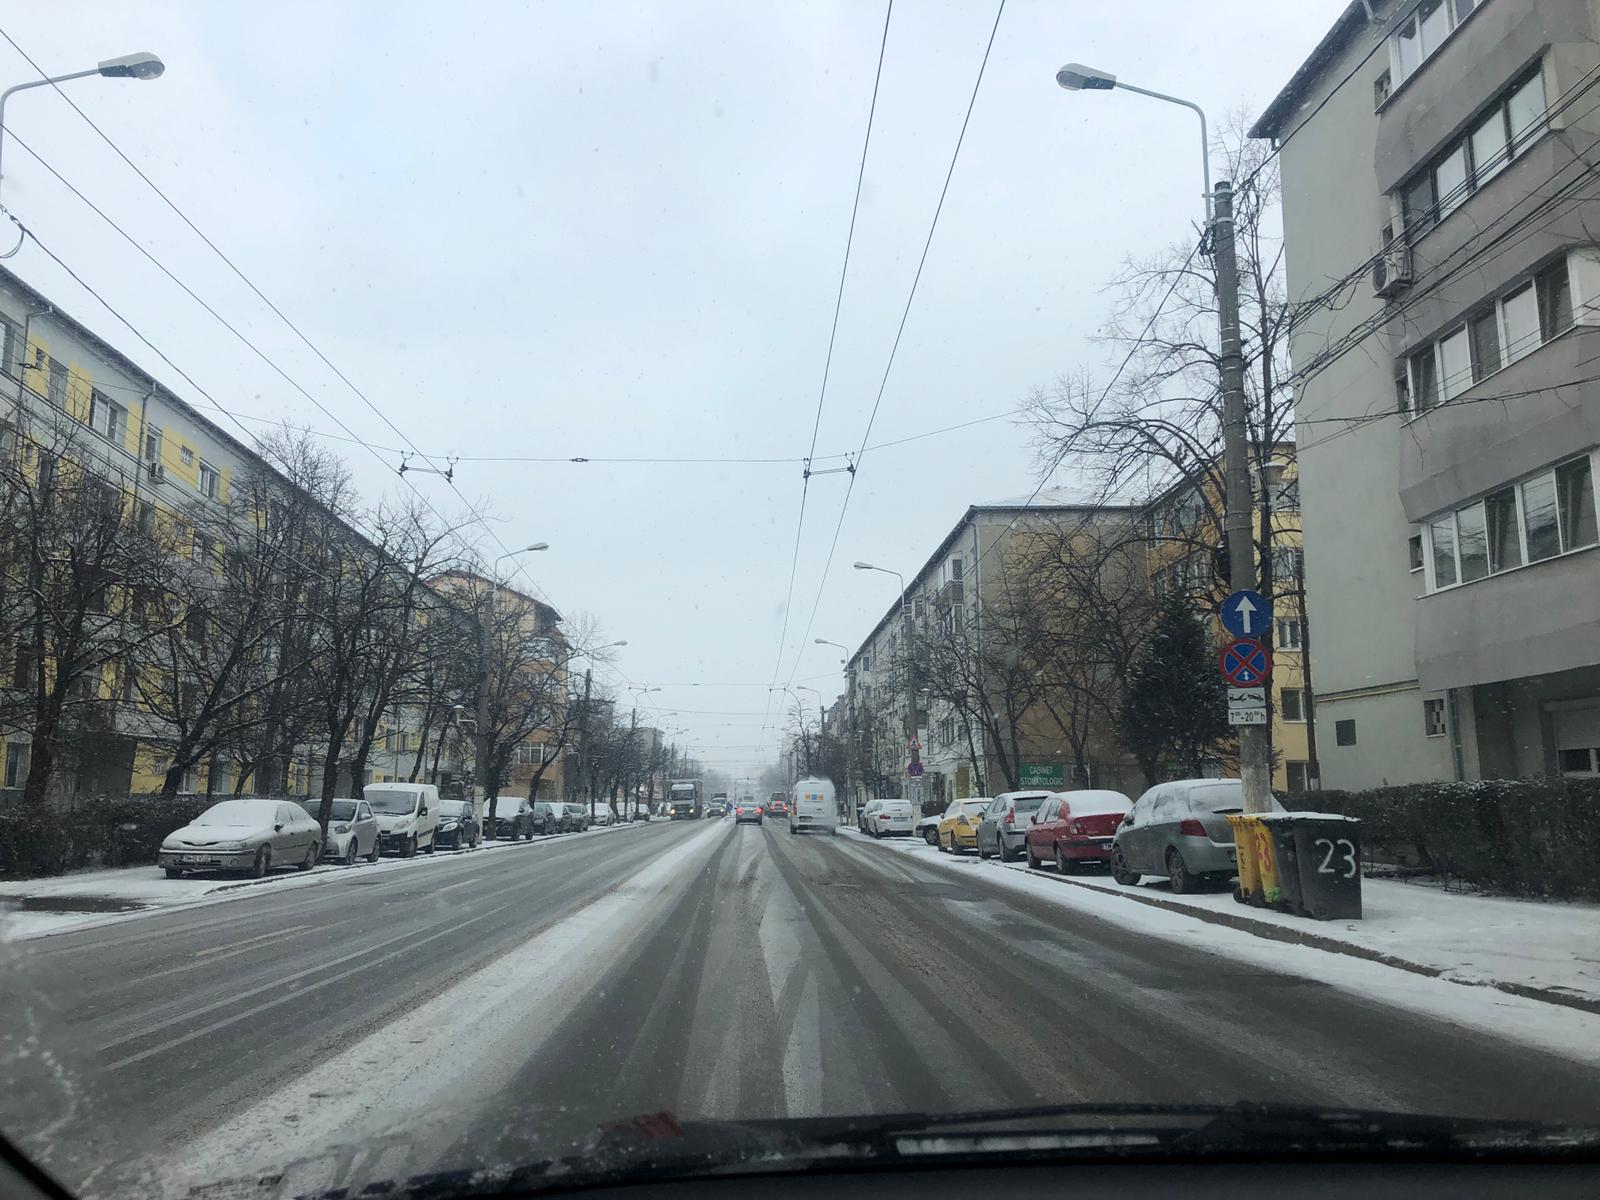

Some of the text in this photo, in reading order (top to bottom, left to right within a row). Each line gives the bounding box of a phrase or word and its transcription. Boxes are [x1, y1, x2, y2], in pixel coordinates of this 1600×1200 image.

[1029, 765, 1054, 775] CABINET
[1020, 776, 1064, 786] STOMATOLOGIC
[1314, 838, 1357, 879] 23
